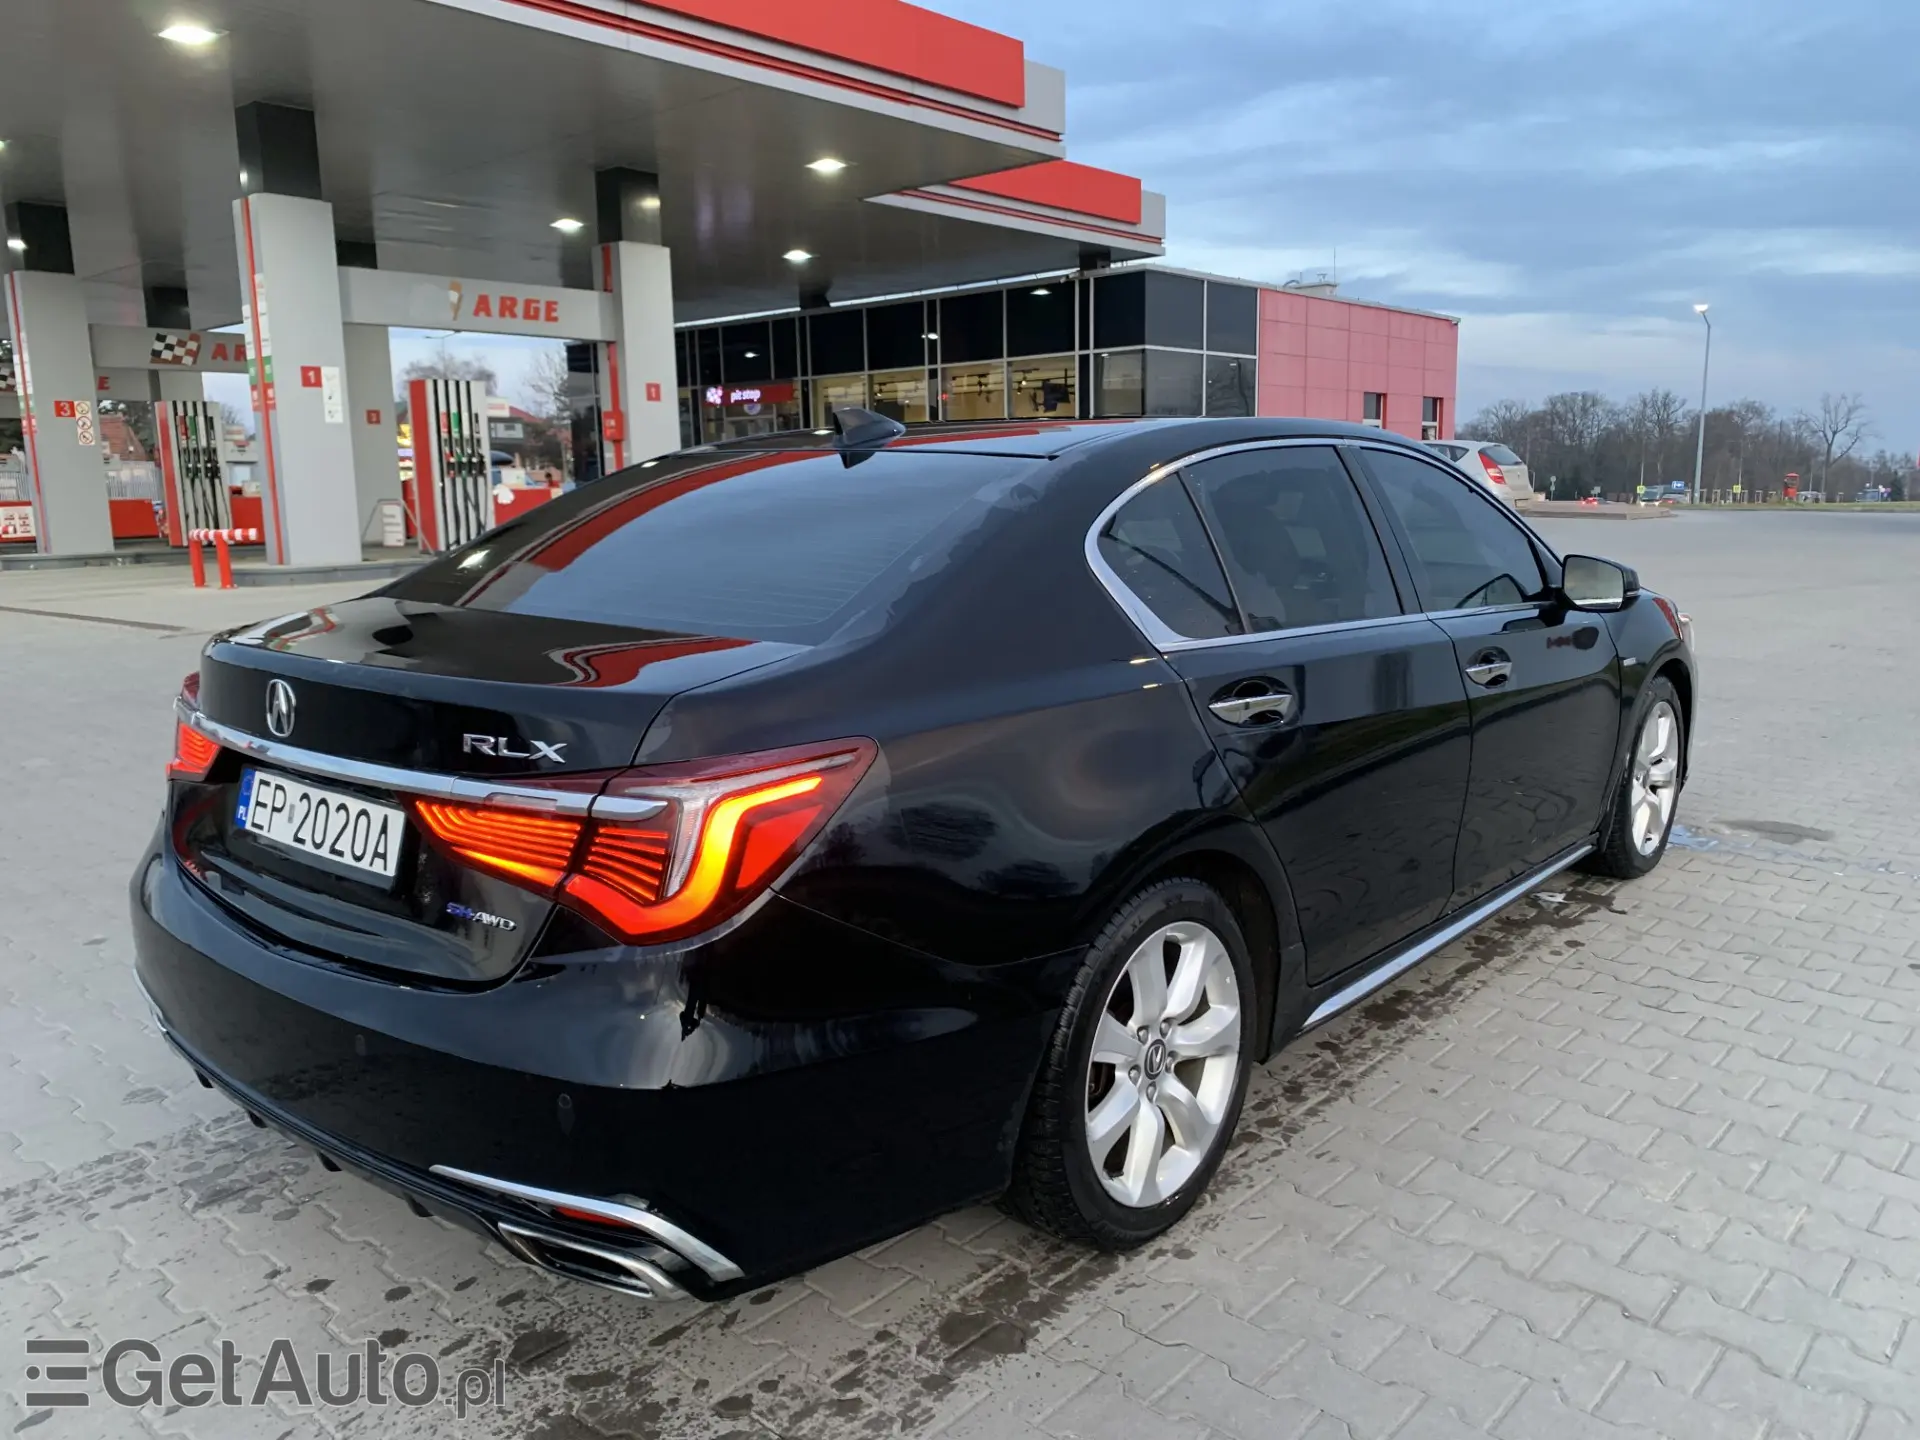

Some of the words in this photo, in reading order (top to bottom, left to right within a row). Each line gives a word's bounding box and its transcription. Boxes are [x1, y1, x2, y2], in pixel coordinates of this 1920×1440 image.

[473, 293, 560, 323] ARGE
[211, 342, 248, 362] AR
[307, 370, 316, 384] 1
[60, 402, 71, 417] 3
[463, 733, 568, 764] RLX
[251, 778, 287, 833] EP
[293, 792, 389, 872] 2020A
[446, 902, 518, 932] SH-AWD
